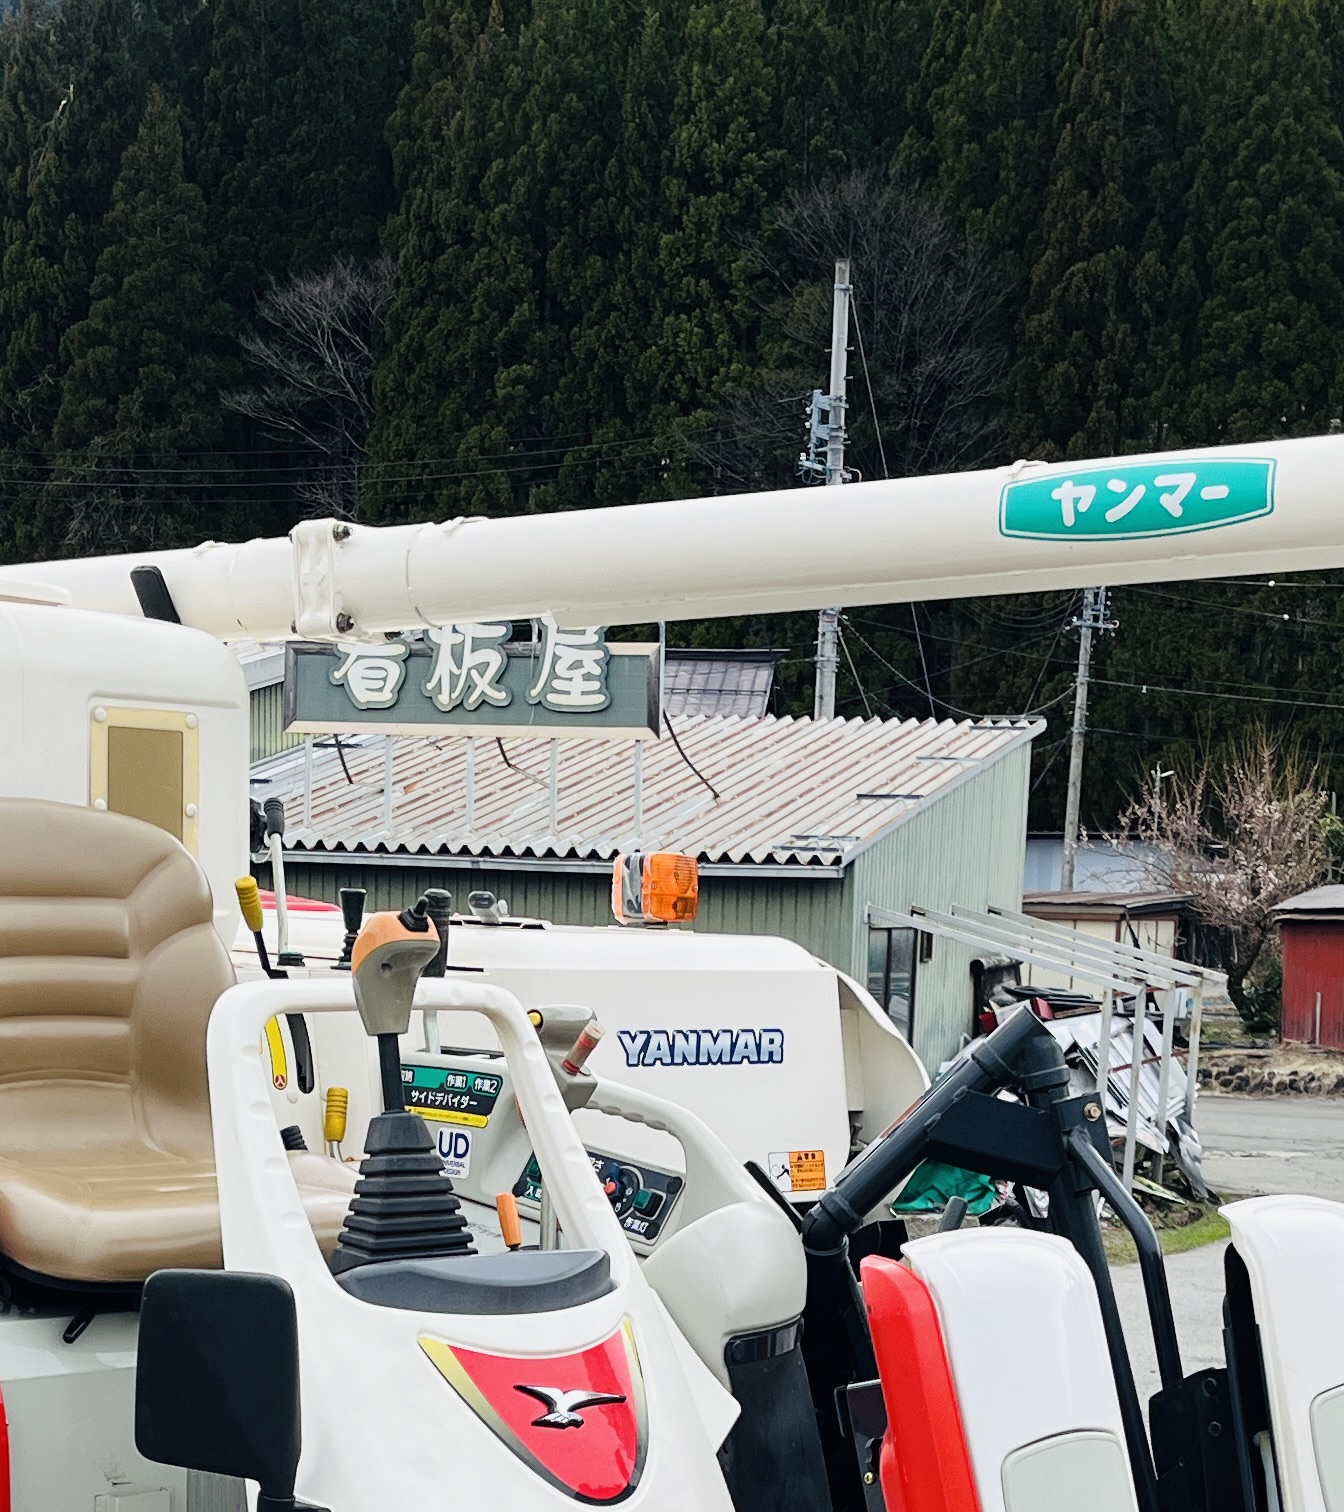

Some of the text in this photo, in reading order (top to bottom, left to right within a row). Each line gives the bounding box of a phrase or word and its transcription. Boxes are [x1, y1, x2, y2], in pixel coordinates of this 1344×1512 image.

[1050, 472, 1231, 528] ヤンマー
[333, 616, 607, 706] 看板屋
[616, 1027, 785, 1068] YANMAR
[438, 1130, 470, 1159] UD
